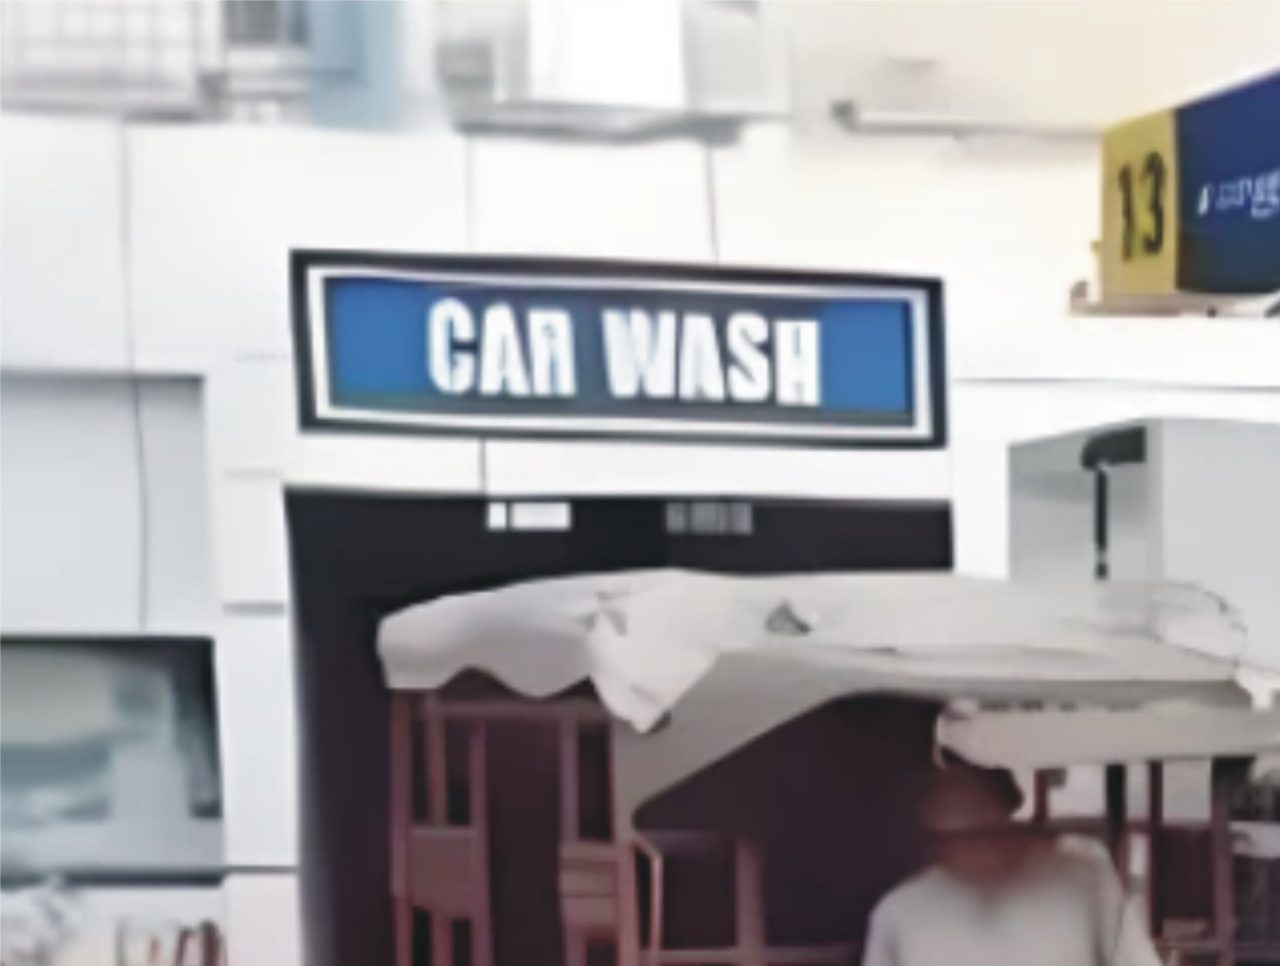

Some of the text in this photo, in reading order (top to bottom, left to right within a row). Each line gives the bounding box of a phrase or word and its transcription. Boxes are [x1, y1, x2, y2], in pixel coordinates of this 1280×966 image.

[1118, 151, 1166, 262] 13
[428, 298, 821, 407] CAR WASH
